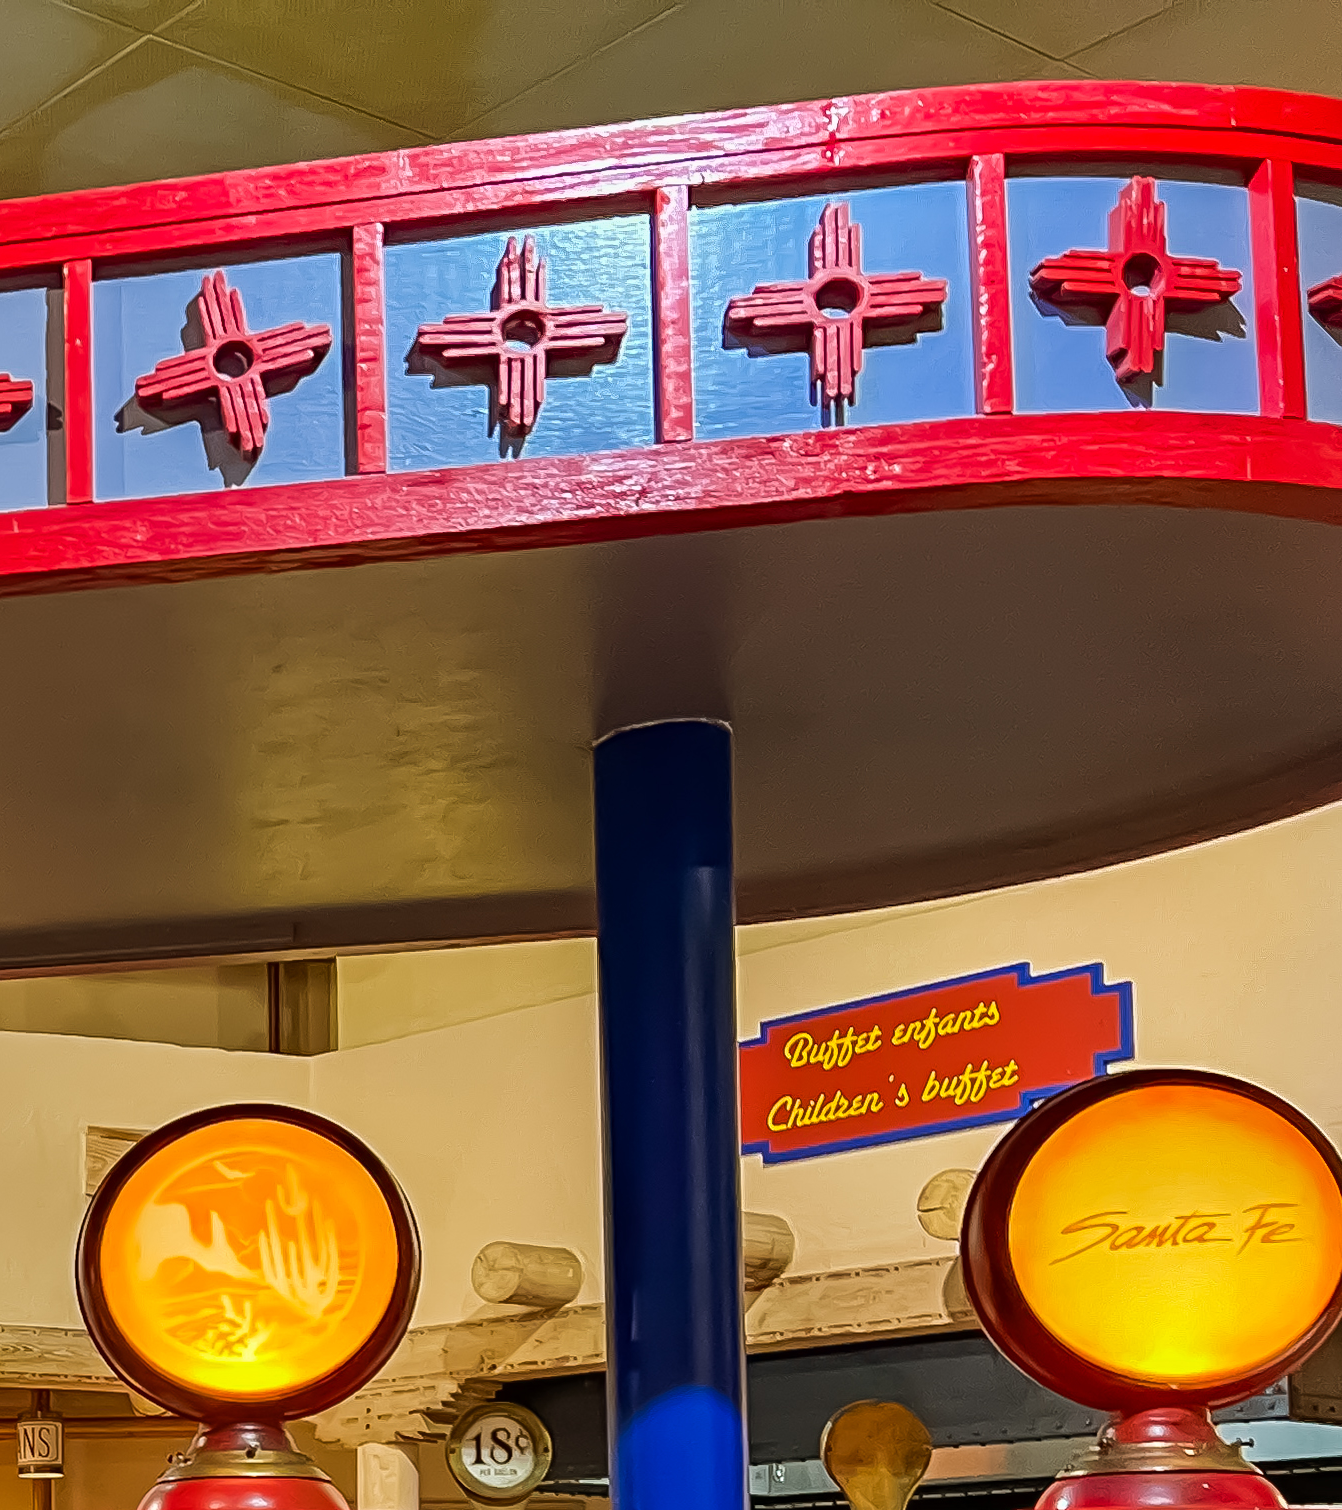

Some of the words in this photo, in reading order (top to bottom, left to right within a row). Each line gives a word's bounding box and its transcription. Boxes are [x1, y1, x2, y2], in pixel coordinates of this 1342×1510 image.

[784, 1025, 882, 1070] Buffet
[891, 1001, 1000, 1050] enfants
[922, 1059, 1019, 1106] buffet
[1049, 1210, 1232, 1266] Santa
[1236, 1202, 1304, 1257] Fe
